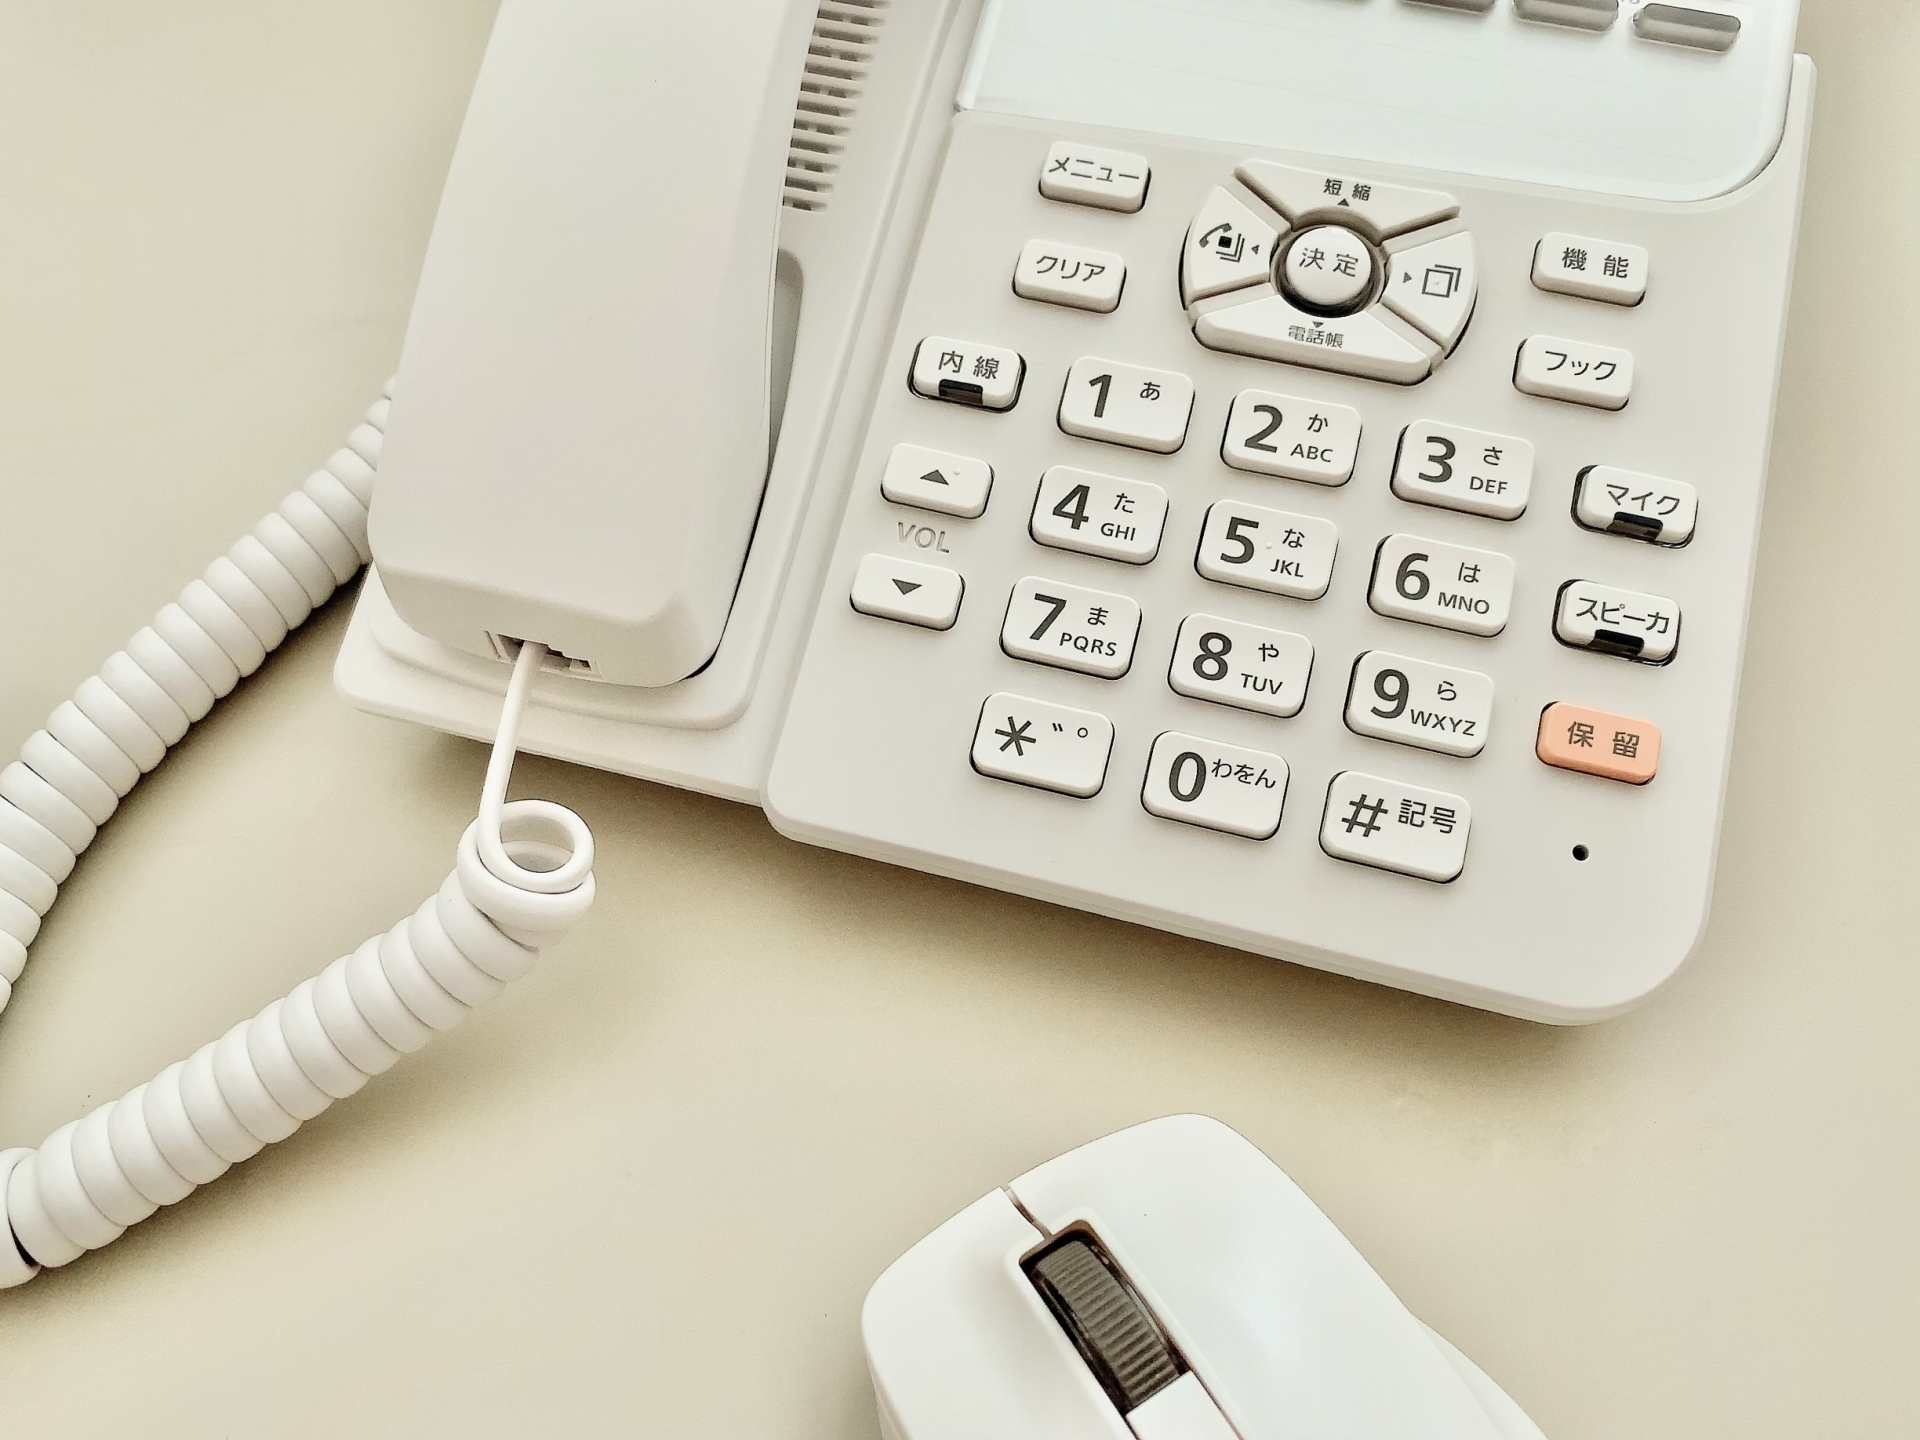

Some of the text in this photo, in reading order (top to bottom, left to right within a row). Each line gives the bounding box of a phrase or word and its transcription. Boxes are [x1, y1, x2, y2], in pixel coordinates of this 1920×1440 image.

[1048, 156, 1140, 183] メニュー
[1036, 255, 1106, 282] クリア
[1287, 325, 1345, 349] 電話帳
[1545, 350, 1617, 381] フック
[1088, 373, 1161, 419] 1 あ
[1243, 404, 1329, 454] 2 か
[1290, 443, 1333, 463] ABC
[1418, 435, 1503, 483] 3 さ
[1469, 476, 1508, 495] DEF
[1606, 483, 1680, 516] マイク
[1052, 484, 1135, 531] 4 た
[896, 520, 950, 554] VOL
[1100, 522, 1136, 542] GHI
[1220, 516, 1305, 565] 5 な
[1270, 558, 1304, 578] JKL
[1395, 552, 1481, 601] 6 は
[1029, 592, 1109, 642] 7 ま
[1437, 591, 1490, 615] MNO
[1575, 597, 1670, 634] スピーカ
[1059, 632, 1117, 657] PQRS
[1192, 631, 1280, 682] 8 や
[1240, 672, 1284, 695] TUV
[1370, 668, 1457, 719] 9 ら
[1410, 708, 1476, 737] WXYZ
[1168, 751, 1277, 803] 0 わをん
[1341, 793, 1457, 838] # 記号
